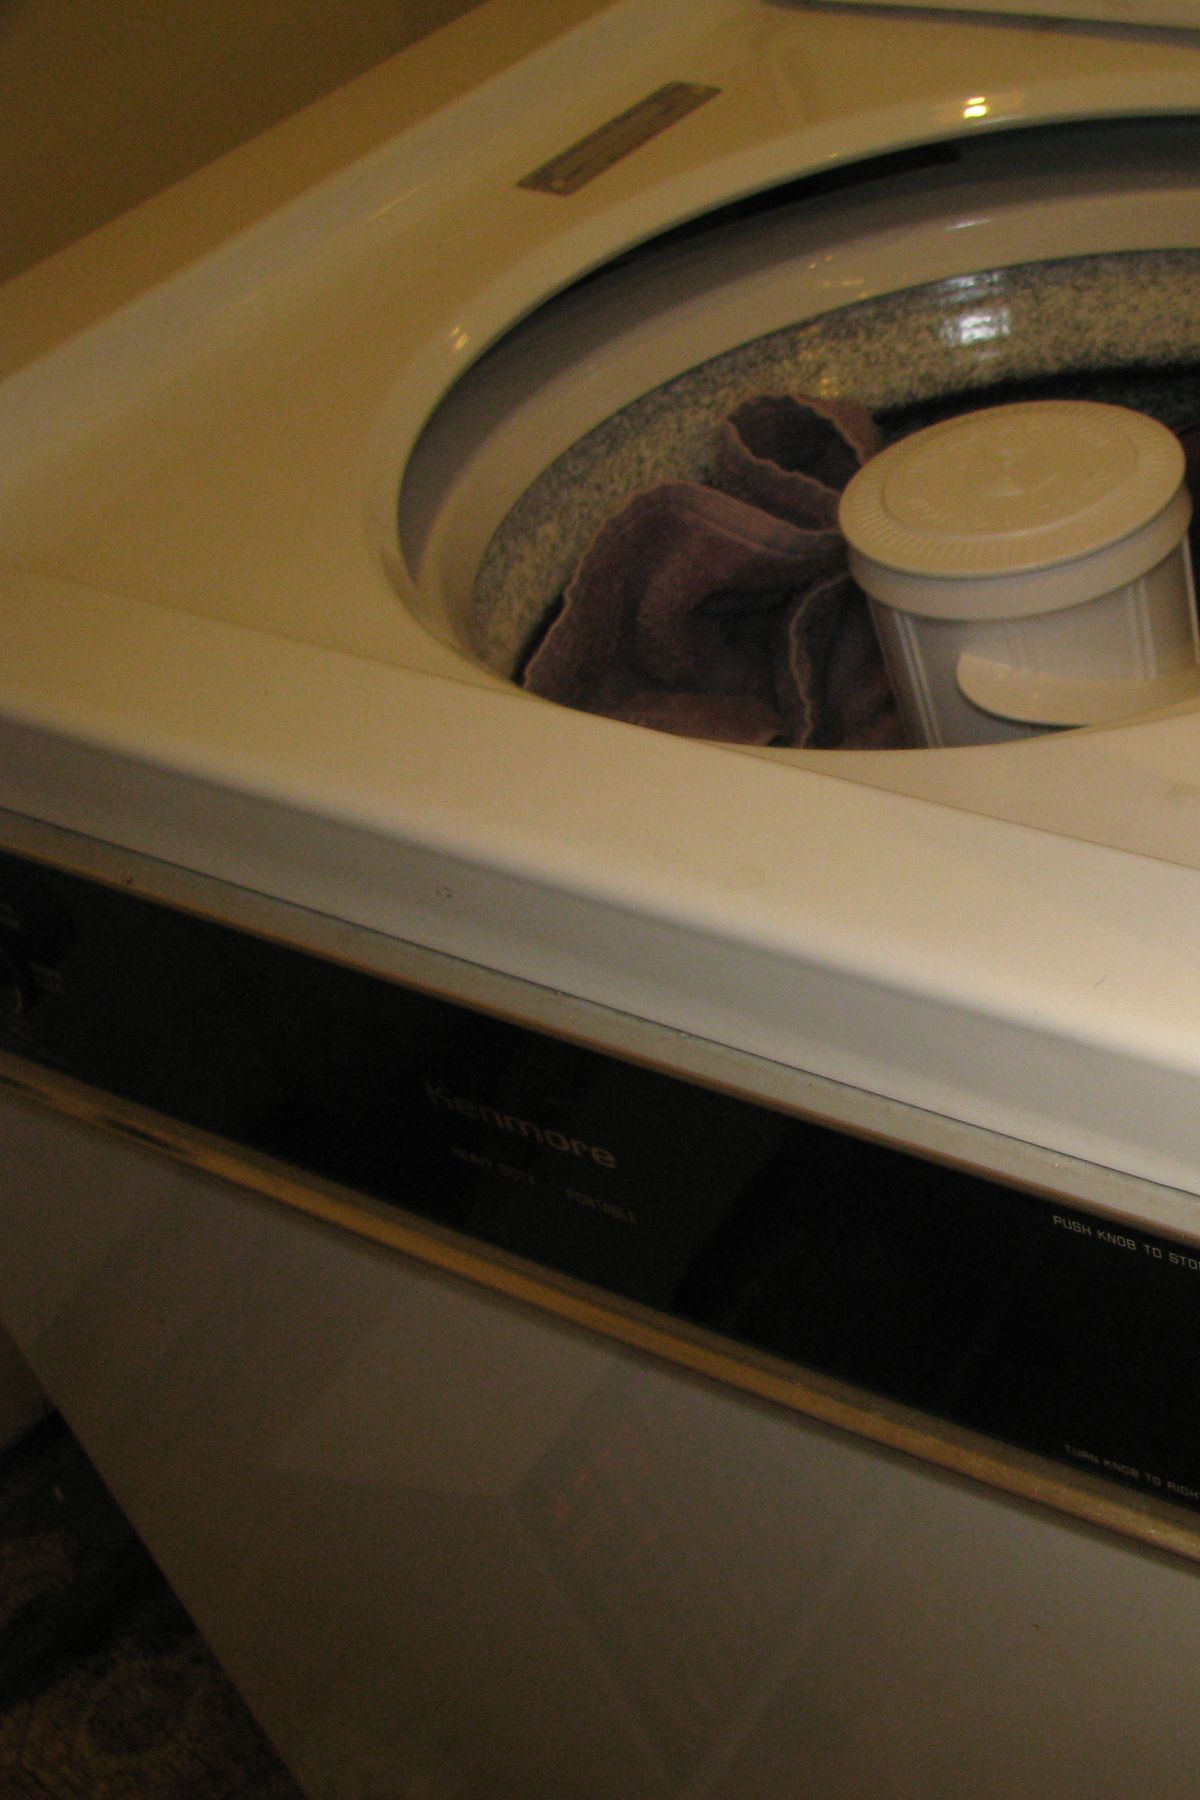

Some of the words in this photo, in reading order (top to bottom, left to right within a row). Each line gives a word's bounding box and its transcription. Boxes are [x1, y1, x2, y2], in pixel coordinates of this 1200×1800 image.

[422, 1078, 620, 1168] Kenmore
[1053, 1215, 1092, 1236] PUSH
[1098, 1229, 1137, 1250] KNOB
[1144, 1244, 1163, 1259] TO
[1064, 1444, 1099, 1464] TURN
[1103, 1459, 1139, 1478] KNOB
[1144, 1472, 1162, 1487] TO
